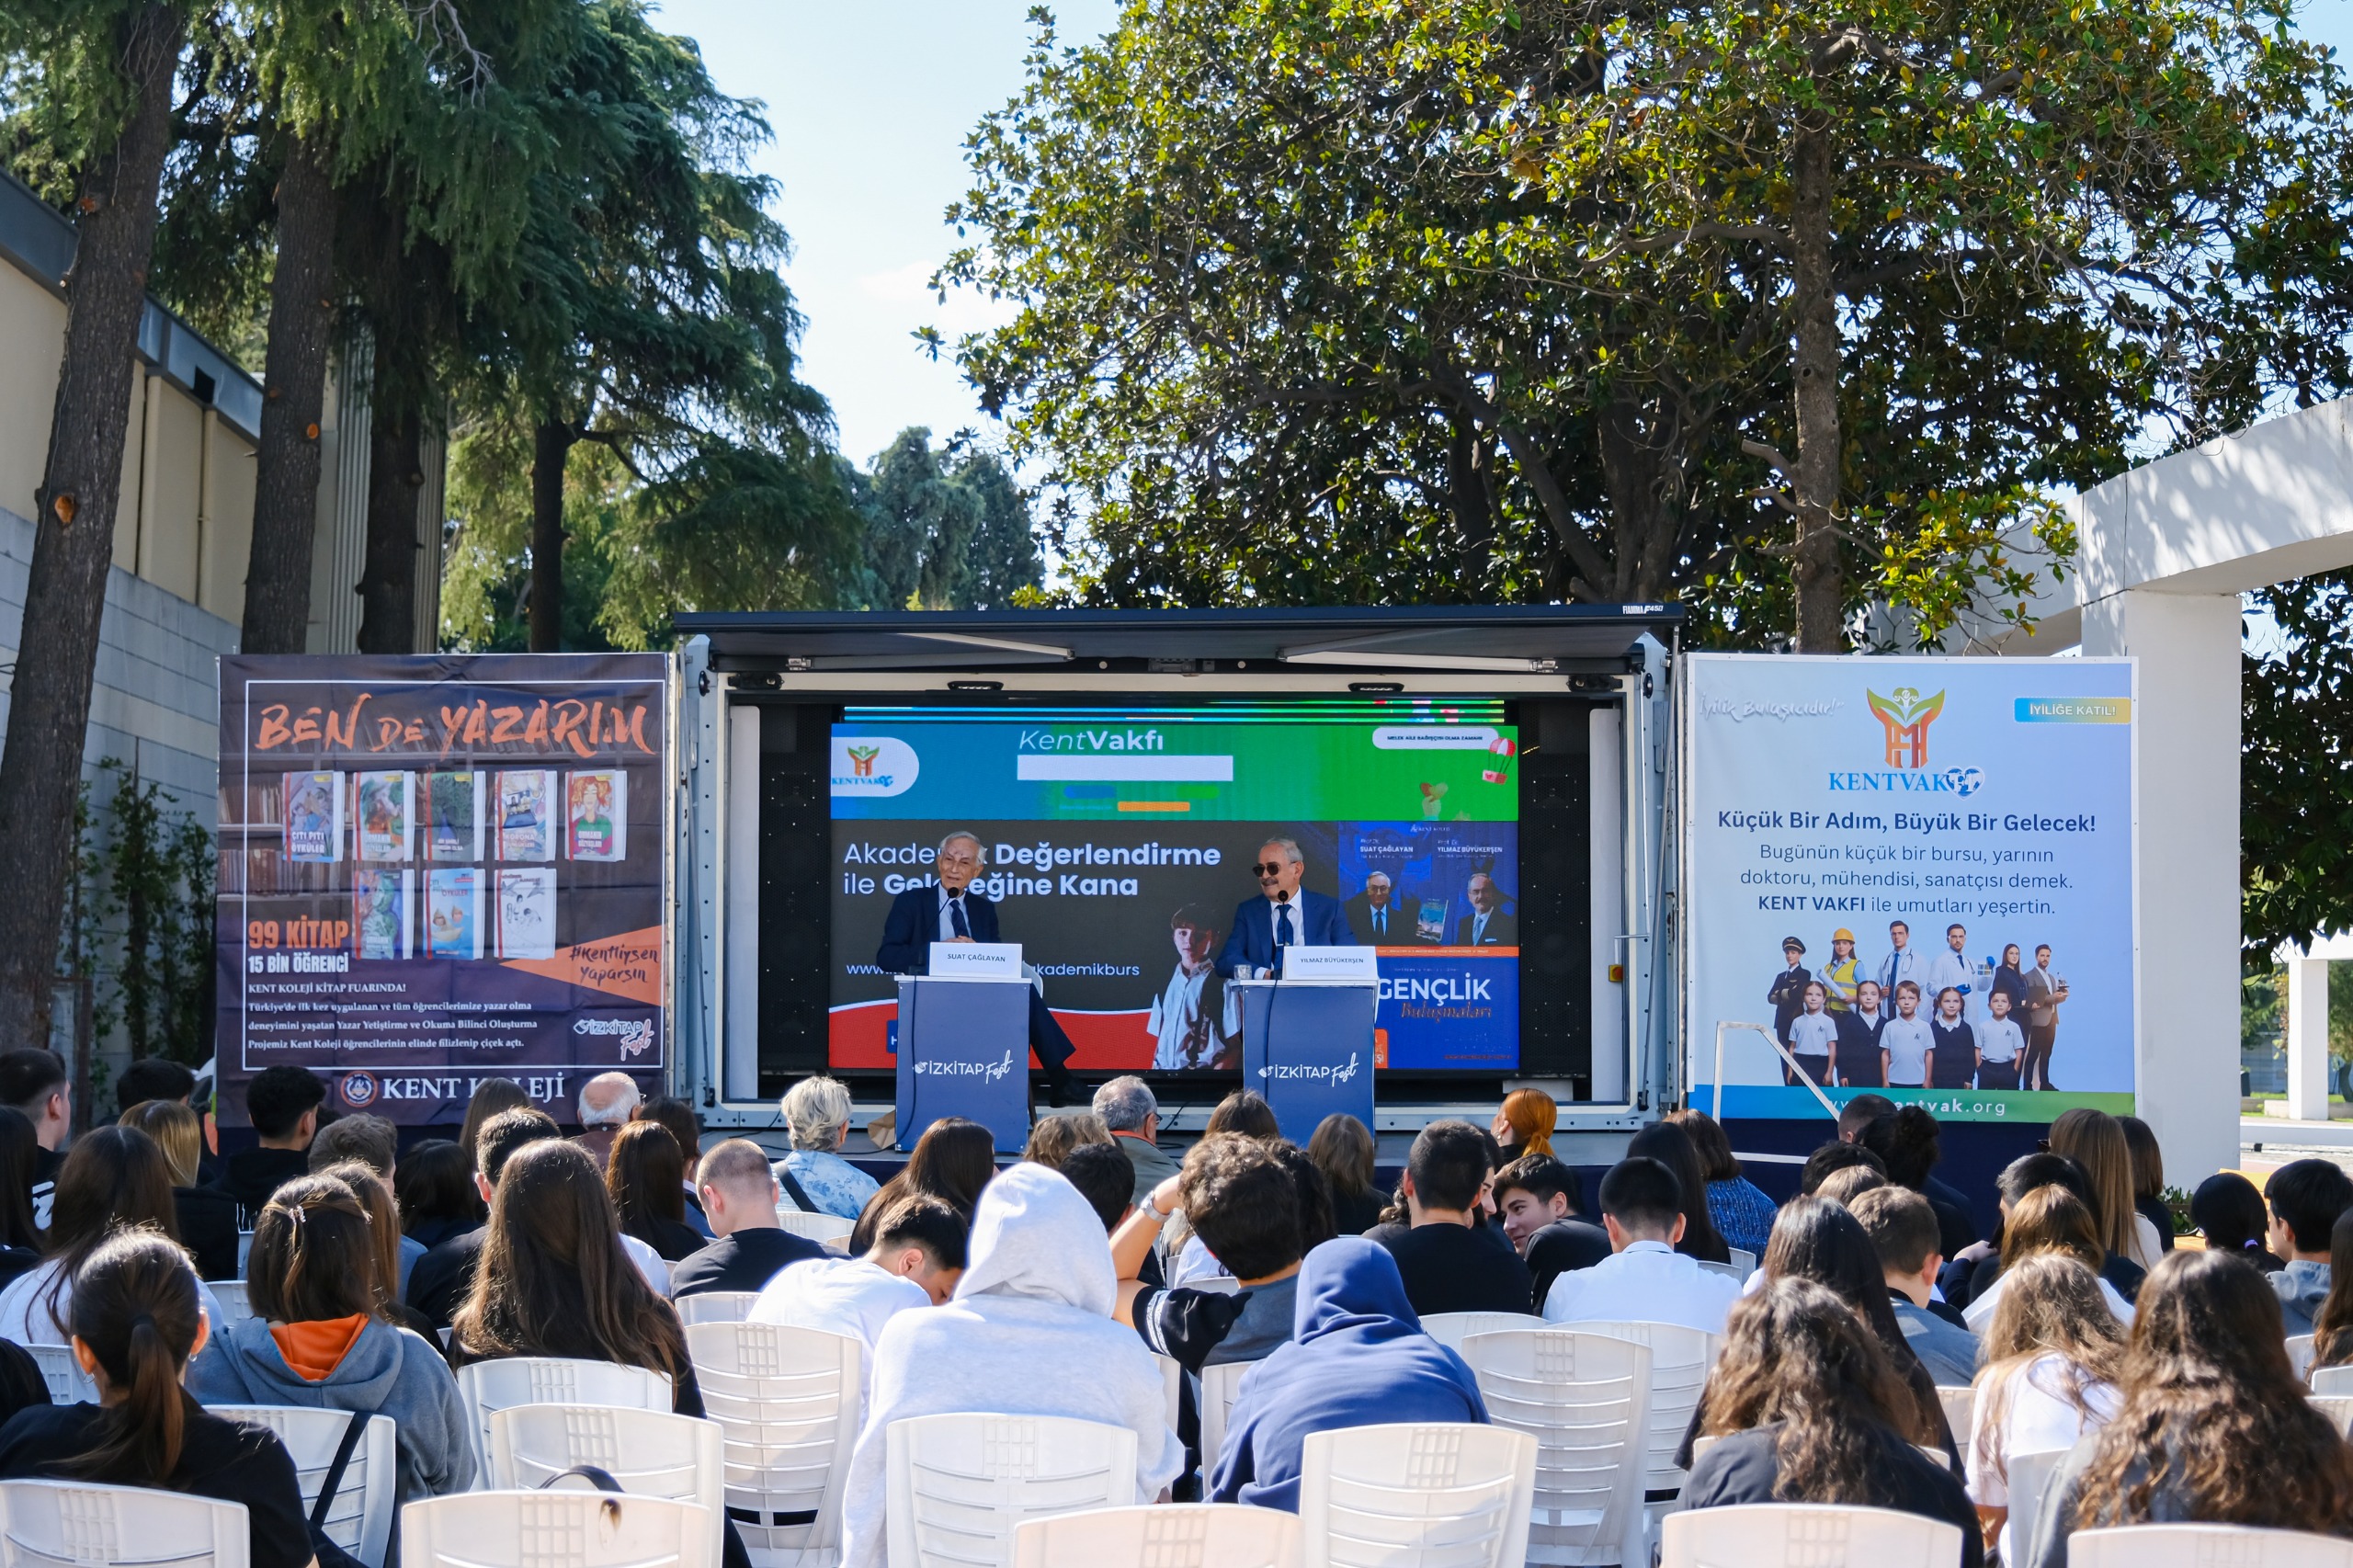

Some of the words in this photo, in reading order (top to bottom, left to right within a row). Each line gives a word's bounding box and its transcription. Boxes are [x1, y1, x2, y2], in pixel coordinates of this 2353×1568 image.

[2029, 703, 2073, 715] İYİLİĞE
[2076, 706, 2116, 716] KATIL!
[255, 693, 371, 751] BEN
[440, 699, 656, 762] YAZARIM
[1019, 730, 1164, 751] KentVakfı
[1718, 811, 1783, 833] Küçük
[1790, 812, 1820, 829] Bir
[1825, 812, 1888, 834] Adım,
[1894, 813, 1961, 835] Büyük
[1968, 813, 1997, 831] Bir
[2004, 813, 2096, 832] Gelecek!
[995, 842, 1222, 872] Değerlendirme
[1378, 845, 1414, 854] ÇAĞLAYAN
[1760, 844, 1839, 863] Bugünün
[1846, 845, 1896, 865] küçük
[1903, 846, 1927, 861] bir
[1931, 846, 1987, 865] bursu,
[1993, 850, 2053, 866] yarının
[844, 872, 875, 894] ile
[1060, 875, 1138, 896] Kana
[1740, 869, 1815, 888] doktoru,
[1822, 870, 1920, 890] mühendisi,
[1925, 873, 2003, 892] sanatçısı
[2008, 873, 2073, 889] demek.
[1758, 895, 1807, 911] KENT
[1812, 897, 1865, 912] VAKFI
[1871, 897, 1892, 912] ile
[1896, 898, 1972, 914] umutları
[1978, 899, 2055, 917] yeşertin.
[248, 921, 279, 949] 99
[286, 915, 349, 949] KİTAP
[248, 956, 264, 973] 15
[267, 952, 290, 973] BİN
[292, 952, 349, 973] ÖĞRENCİ
[967, 953, 1006, 962] ÇAĞLAYAN
[1324, 956, 1364, 964] BÜYÜKERŞEN
[248, 984, 277, 994] KENT
[278, 982, 313, 994] KOLEJİ
[316, 982, 347, 994] KİTAP
[347, 983, 406, 993] FUARINDA!
[1379, 972, 1492, 1006] GENÇLİK
[248, 1003, 296, 1014] Türkiye'de
[298, 1002, 311, 1011] ilk
[313, 1003, 329, 1011] kez
[331, 1002, 379, 1014] uygulanan
[392, 1002, 411, 1011] tüm
[413, 1002, 482, 1013] öğrencilerimize
[483, 1004, 508, 1012] yazar
[508, 1001, 532, 1010] olma
[248, 1021, 300, 1032] deneyimini
[301, 1021, 335, 1032] yaşatan
[336, 1021, 361, 1029] Yazar
[362, 1020, 408, 1031] Yetiştirme
[422, 1020, 456, 1029] Okuma
[458, 1020, 487, 1028] Bilinci
[489, 1019, 538, 1030] Oluşturma
[248, 1040, 289, 1051] Projemiz
[290, 1040, 313, 1049] Kent
[313, 1039, 341, 1051] Koleji
[343, 1039, 406, 1051] öğrencilerinin
[407, 1039, 438, 1048] elinde
[438, 1038, 479, 1050] filizlenip
[481, 1038, 504, 1049] çiçek
[506, 1039, 525, 1049] açtı.
[928, 1060, 984, 1075] İZKİTAP
[985, 1049, 1014, 1085] Fest
[1275, 1063, 1330, 1079] İZKİTAP
[1331, 1051, 1359, 1087] Fest
[382, 1077, 461, 1099] KENT
